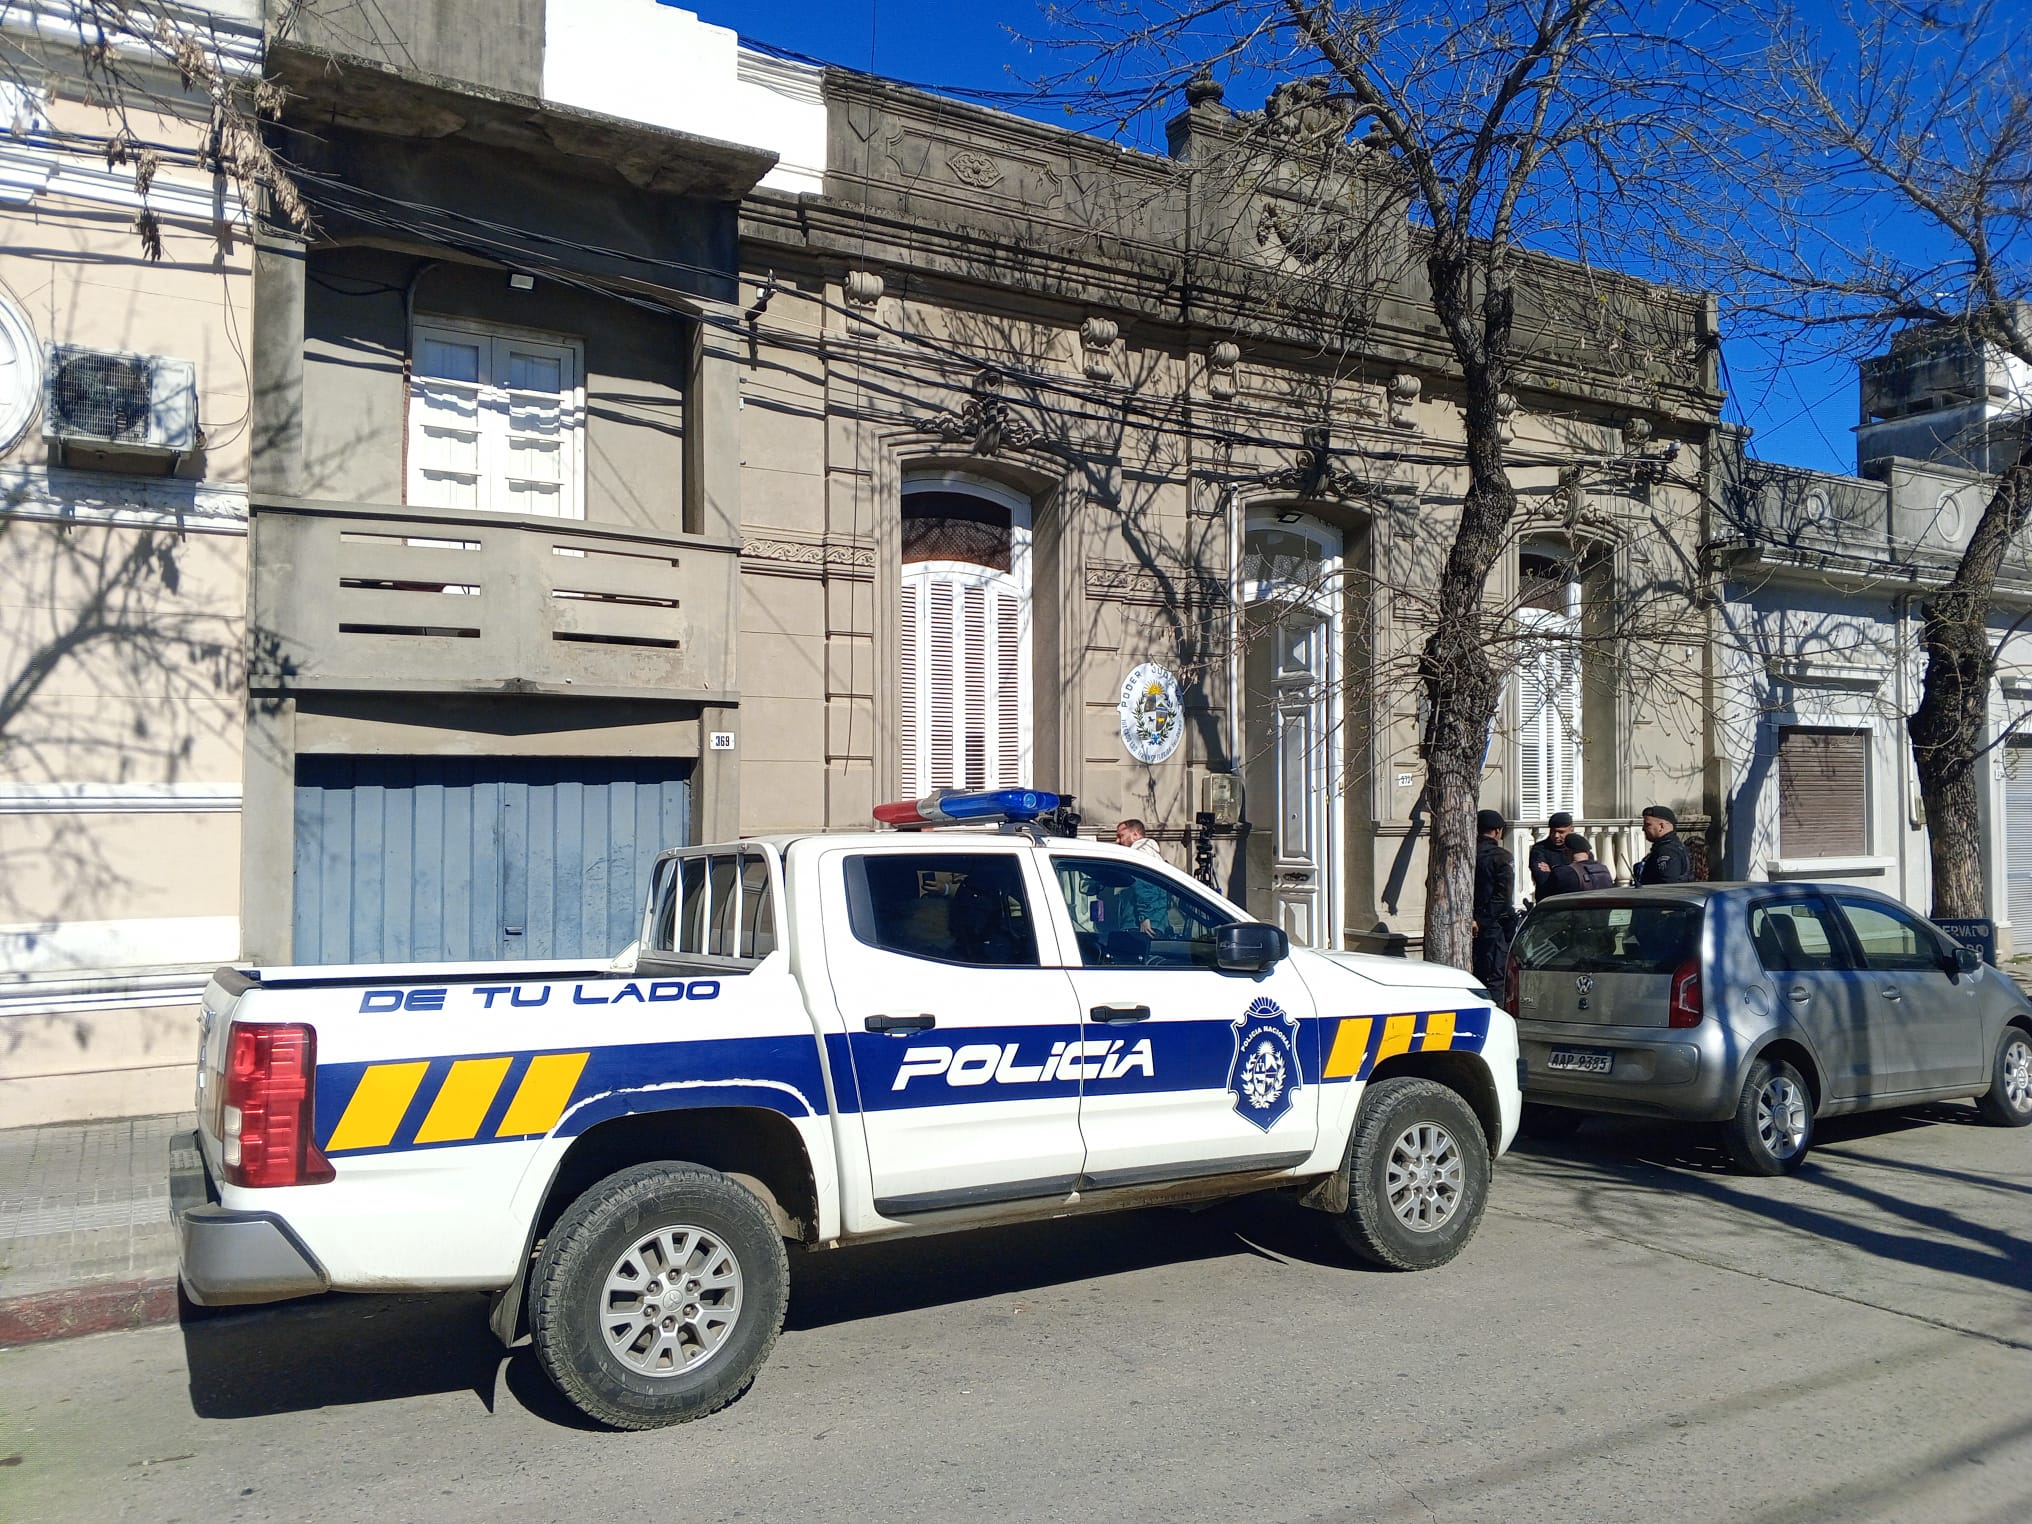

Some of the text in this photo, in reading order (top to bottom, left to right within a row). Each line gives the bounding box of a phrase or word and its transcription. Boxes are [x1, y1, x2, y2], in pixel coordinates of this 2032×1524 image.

[1121, 671, 1142, 708] PODER
[715, 735, 730, 747] 369
[1941, 924, 1989, 937] ERVADO
[359, 980, 721, 1013] DE TU LADO
[1263, 1025, 1292, 1051] NACIONAL
[1551, 1053, 1574, 1067] AAP
